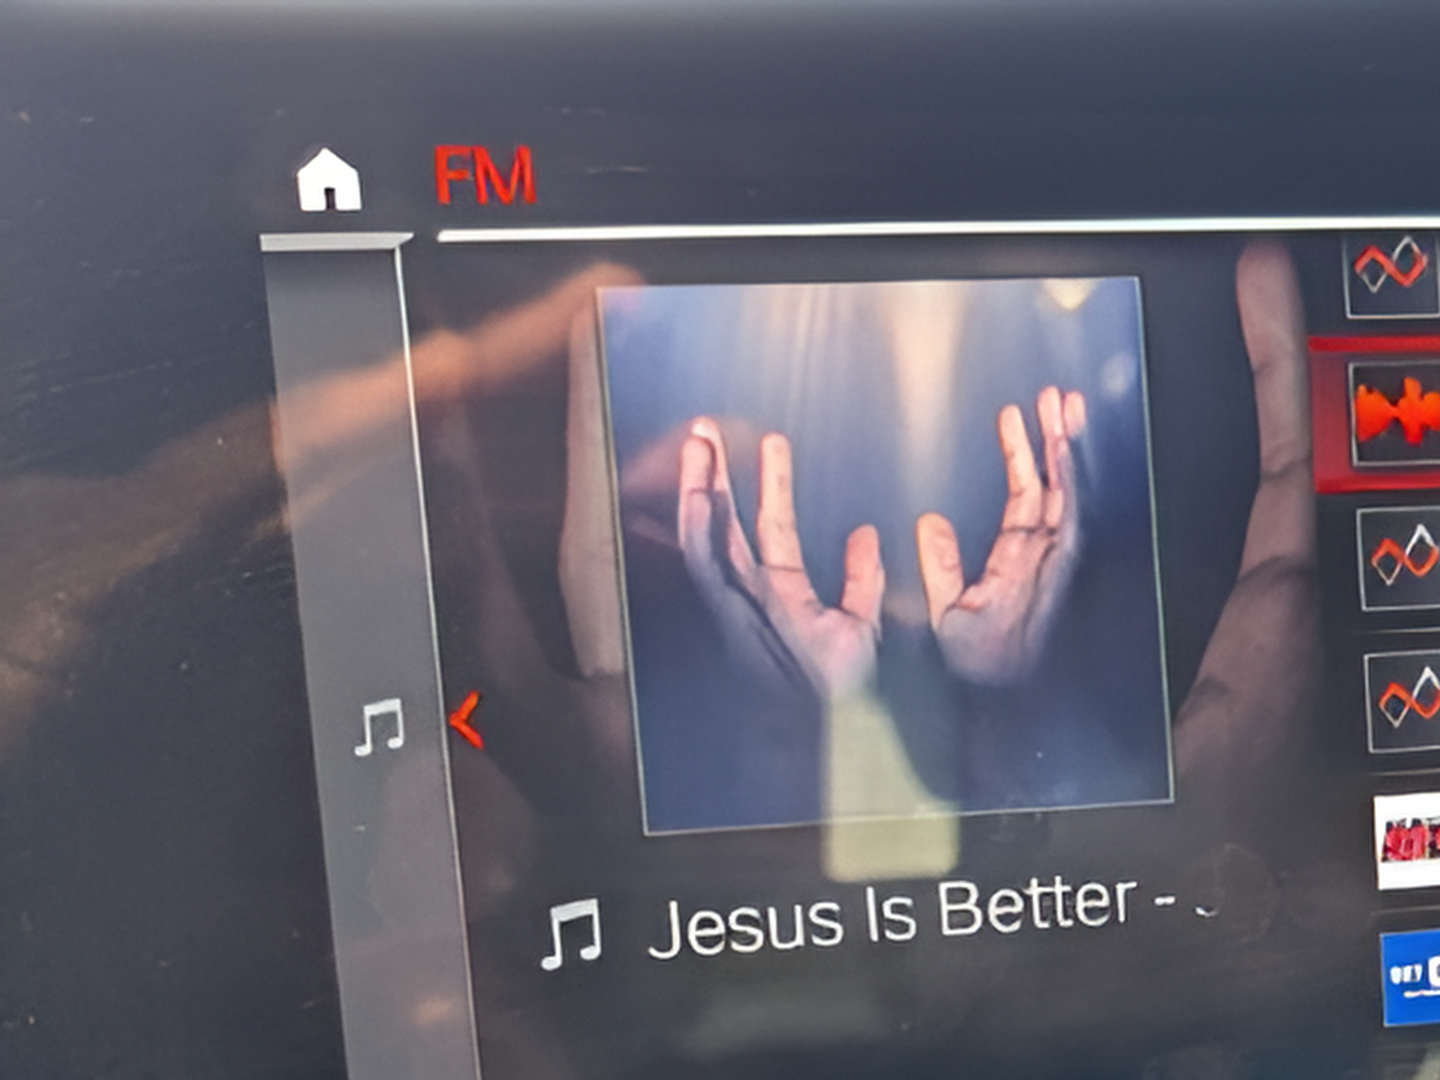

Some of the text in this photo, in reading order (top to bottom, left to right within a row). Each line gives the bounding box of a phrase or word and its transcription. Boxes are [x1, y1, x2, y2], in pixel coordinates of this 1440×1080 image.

[434, 144, 538, 205] FM
[648, 899, 845, 960] Jesus
[865, 884, 917, 943] Is
[938, 874, 1138, 937] Better
